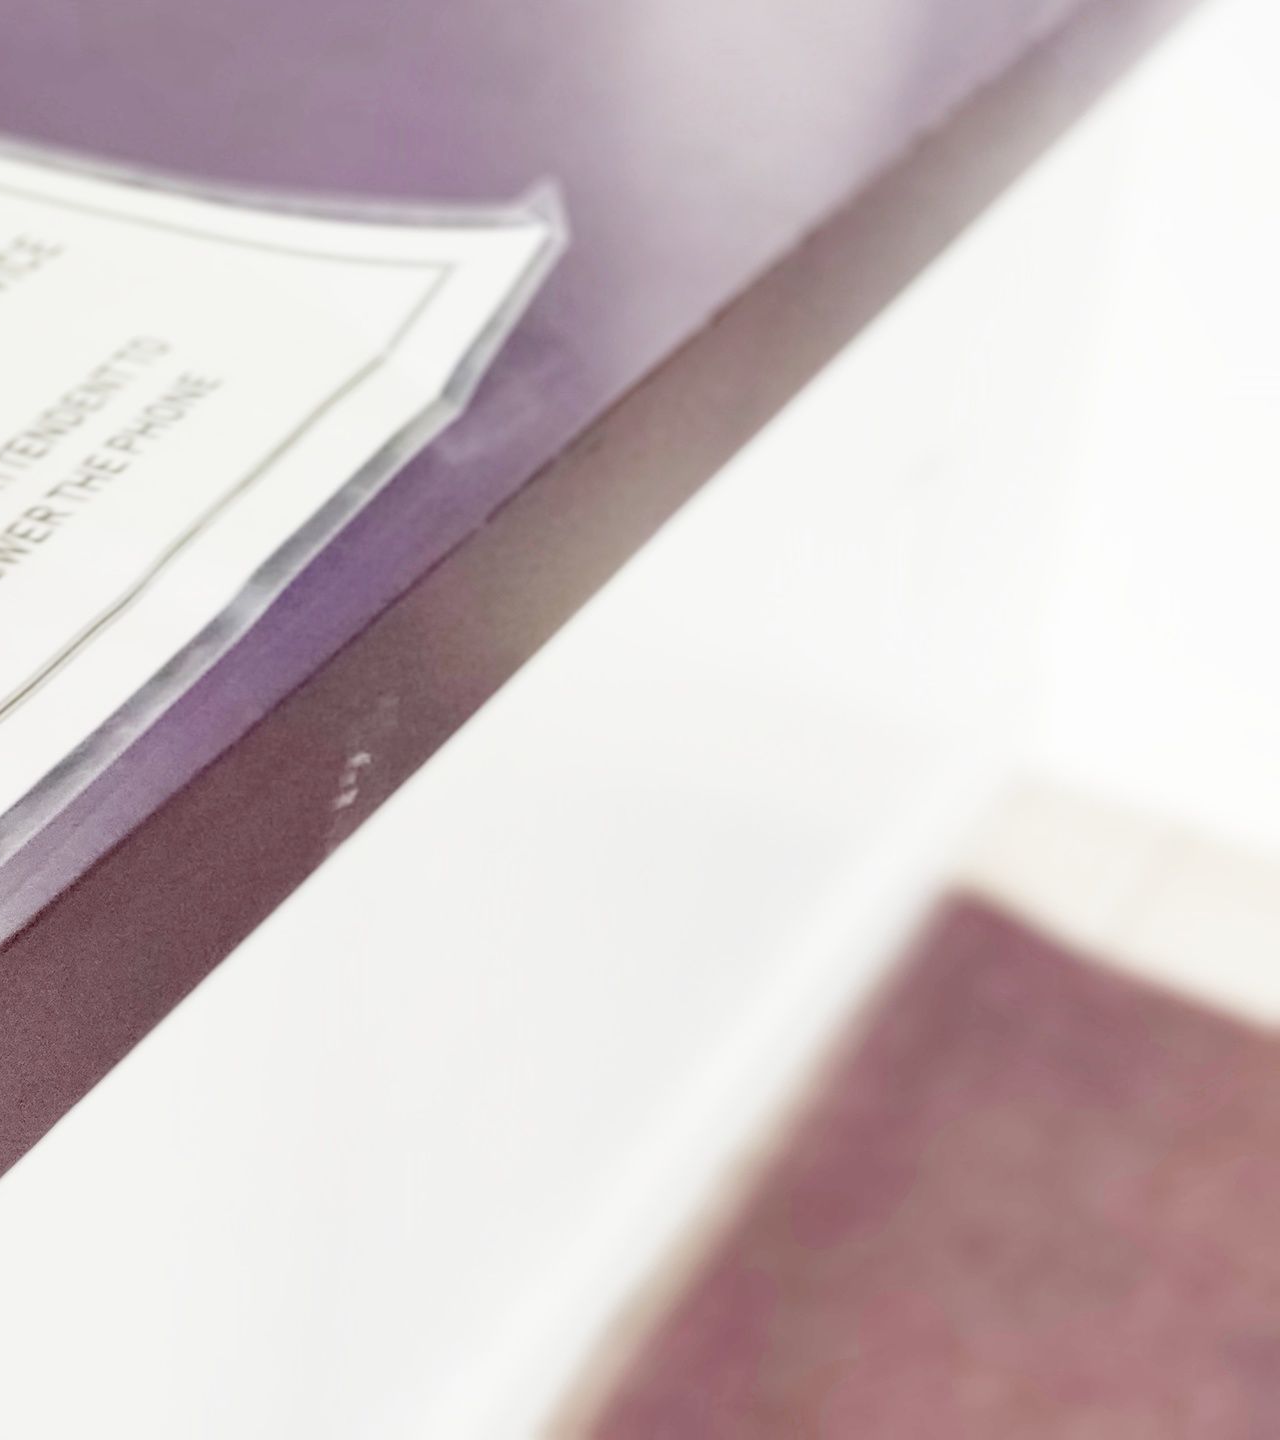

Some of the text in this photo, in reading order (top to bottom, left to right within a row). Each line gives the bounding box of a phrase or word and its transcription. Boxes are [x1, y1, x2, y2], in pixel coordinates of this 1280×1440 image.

[111, 334, 174, 367] TO
[44, 453, 130, 502] THE
[104, 370, 223, 455] PHONE
